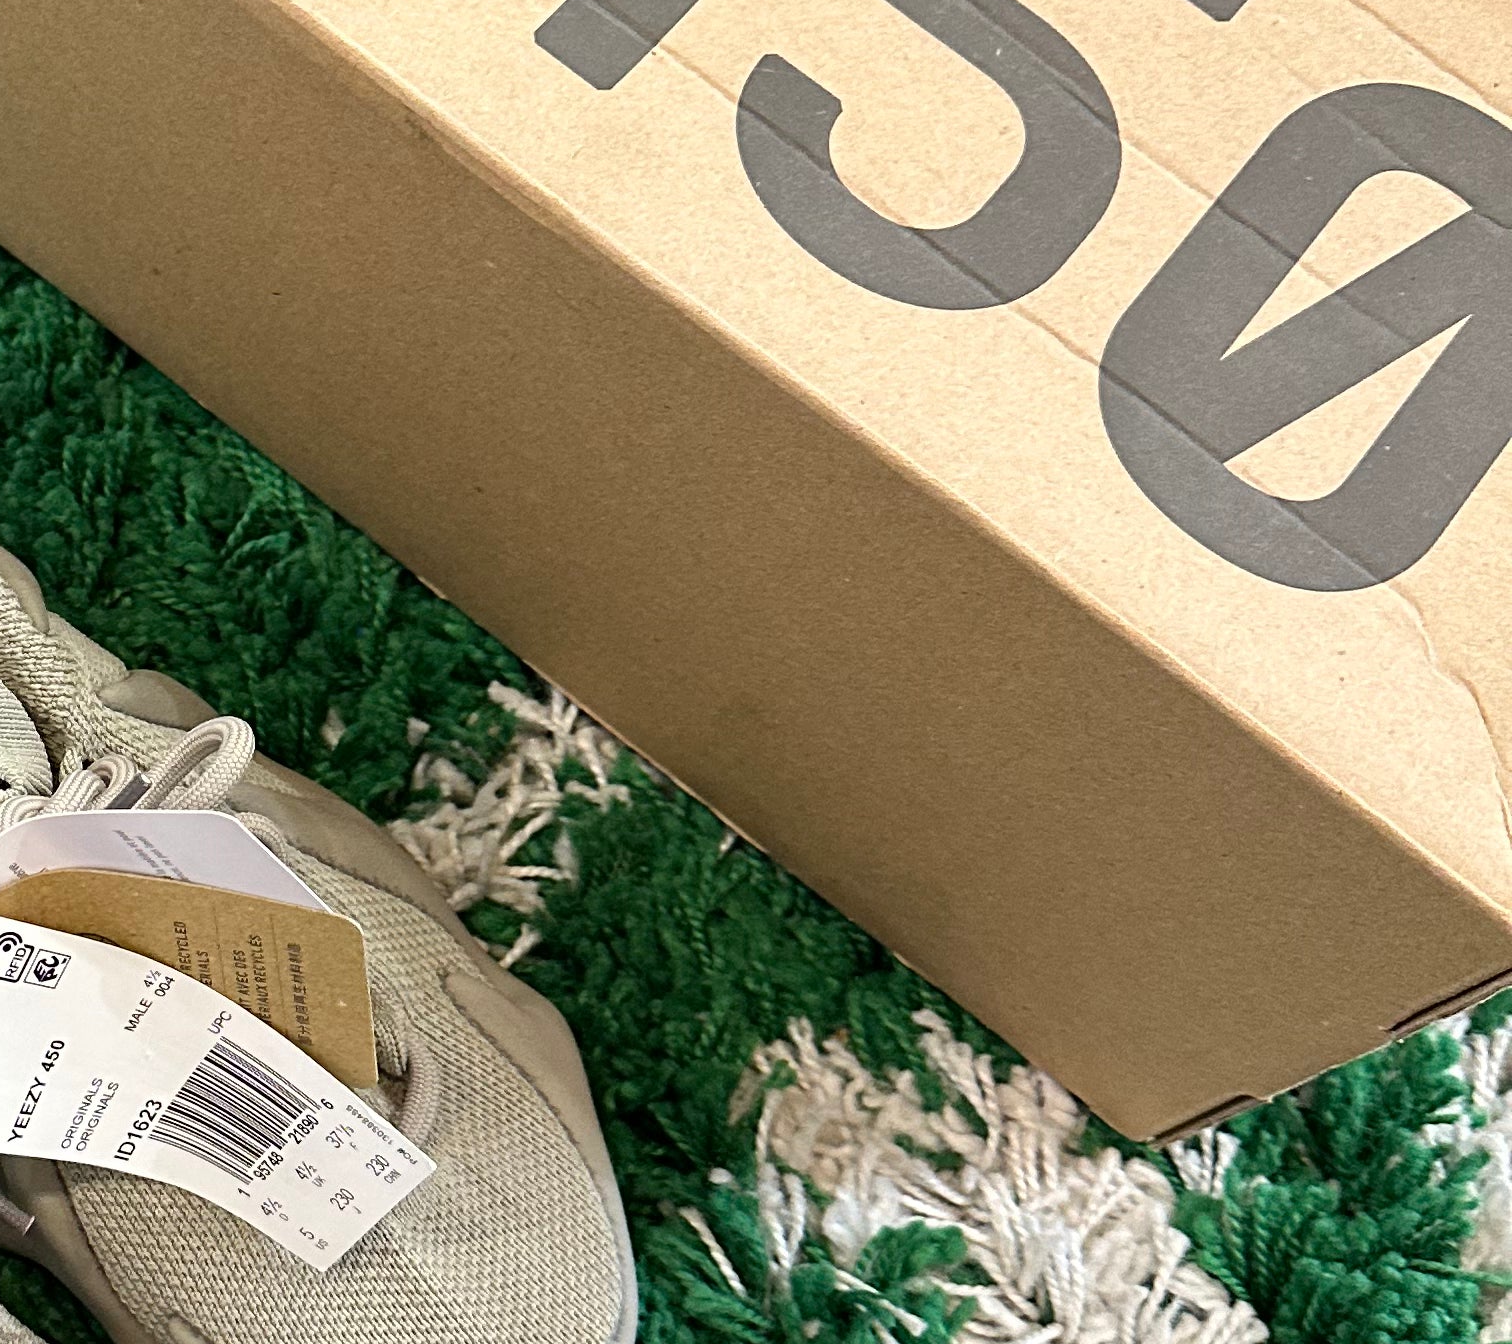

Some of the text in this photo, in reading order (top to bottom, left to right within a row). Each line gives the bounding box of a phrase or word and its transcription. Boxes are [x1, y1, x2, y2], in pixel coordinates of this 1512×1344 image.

[5, 947, 27, 978] RFID
[123, 976, 176, 1033] MALE 004
[207, 1010, 233, 1035] UPC
[7, 1040, 66, 1142] YEEZY 450
[61, 1077, 104, 1149] ORIGINALS
[75, 1081, 120, 1152] ORIGINALS
[114, 1099, 163, 1162] ID1623
[253, 1151, 284, 1181] 95748
[288, 1114, 320, 1145] 21890
[320, 1098, 335, 1110] 6
[312, 1176, 327, 1188] UK
[365, 1154, 391, 1177] 230
[329, 1188, 355, 1212] 230
[299, 1226, 315, 1240] 5
